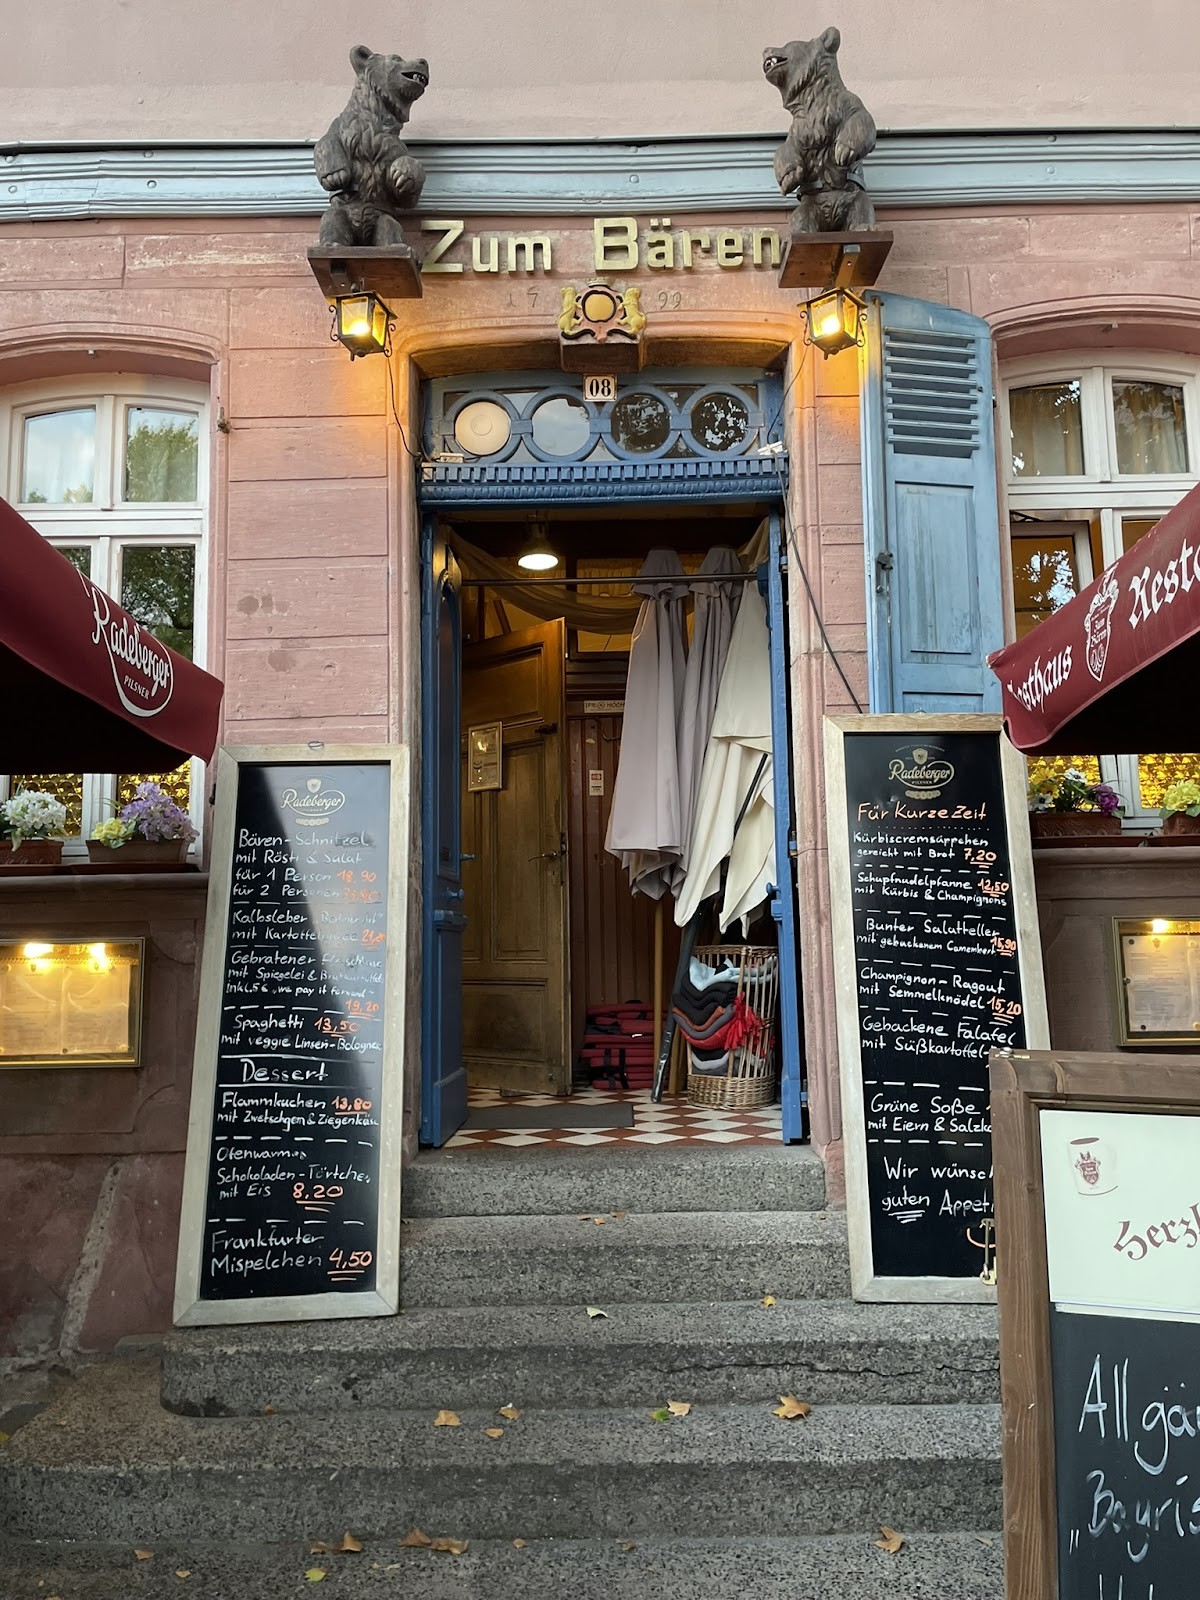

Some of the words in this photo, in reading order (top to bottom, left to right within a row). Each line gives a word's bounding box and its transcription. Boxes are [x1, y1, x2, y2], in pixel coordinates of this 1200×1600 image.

[421, 220, 552, 273] Zum
[594, 216, 782, 273] Bären
[589, 378, 611, 398] 08
[91, 586, 170, 697] Radeberger
[124, 675, 150, 699] PILSNER
[888, 759, 954, 784] Radeberger
[280, 788, 346, 811] Radeberger
[857, 802, 889, 822] Für
[894, 801, 949, 820] Kurze
[951, 802, 987, 820] Zeit
[235, 849, 257, 863] mit
[264, 849, 299, 864] Rösti
[306, 850, 318, 864] &
[324, 851, 362, 864] Salat
[856, 848, 899, 858] gereicht
[903, 848, 922, 858] mit
[928, 847, 956, 859] Brot
[963, 847, 998, 863] 7,20
[235, 869, 261, 880] für
[266, 868, 276, 881] 1
[284, 867, 332, 882] Person
[857, 871, 973, 890] Schupfnudelpfanne
[977, 877, 1010, 893] 12,50
[232, 884, 253, 896] für
[260, 884, 270, 896] 2
[281, 884, 340, 897] Personen
[854, 885, 875, 895] mit
[882, 886, 919, 898] Kürbis
[924, 888, 935, 900] &
[937, 890, 1008, 907] Champignons
[232, 909, 308, 924] Kalbsleber
[232, 929, 257, 940] mit
[866, 918, 914, 933] Bunter
[924, 918, 1001, 937] Salatteller
[856, 932, 877, 943] mit
[880, 935, 943, 950] gebackenem
[231, 950, 316, 965] Gebratener
[228, 964, 249, 979] mit
[255, 966, 305, 982] Spiegelei
[307, 969, 318, 981] &
[295, 985, 315, 997] pay
[318, 984, 327, 995] it
[859, 982, 880, 995] mit
[889, 985, 986, 1009] Semmelknödel
[986, 996, 1022, 1016] 15,20
[344, 999, 380, 1014] 19,20
[233, 1013, 304, 1032] Spaghetti
[314, 1016, 361, 1033] 13,50
[862, 1015, 949, 1037] Gebackene
[957, 1021, 1017, 1046] Falafel
[221, 1031, 241, 1045] mit
[248, 1036, 291, 1051] veggie
[862, 1034, 887, 1049] mit
[240, 1058, 329, 1083] Dessert
[222, 1091, 327, 1110] Flammkuchen
[331, 1095, 372, 1111] 13,80
[870, 1092, 920, 1114] Grüne
[930, 1095, 981, 1117] Soße
[217, 1108, 238, 1123] mit
[243, 1109, 305, 1132] Zwetschgen
[307, 1112, 316, 1126] &
[867, 1116, 888, 1131] mit
[892, 1116, 930, 1132] Eiern
[934, 1116, 945, 1131] &
[884, 1156, 919, 1180] Wir
[219, 1185, 239, 1200] mit
[246, 1183, 272, 1197] Eis
[292, 1182, 344, 1200] 8,20
[881, 1185, 930, 1211] guten
[212, 1225, 325, 1253] Frankfurter
[211, 1250, 322, 1278] Mispelchen
[329, 1247, 373, 1269] 4,50
[1078, 1353, 1200, 1476] Allgä
